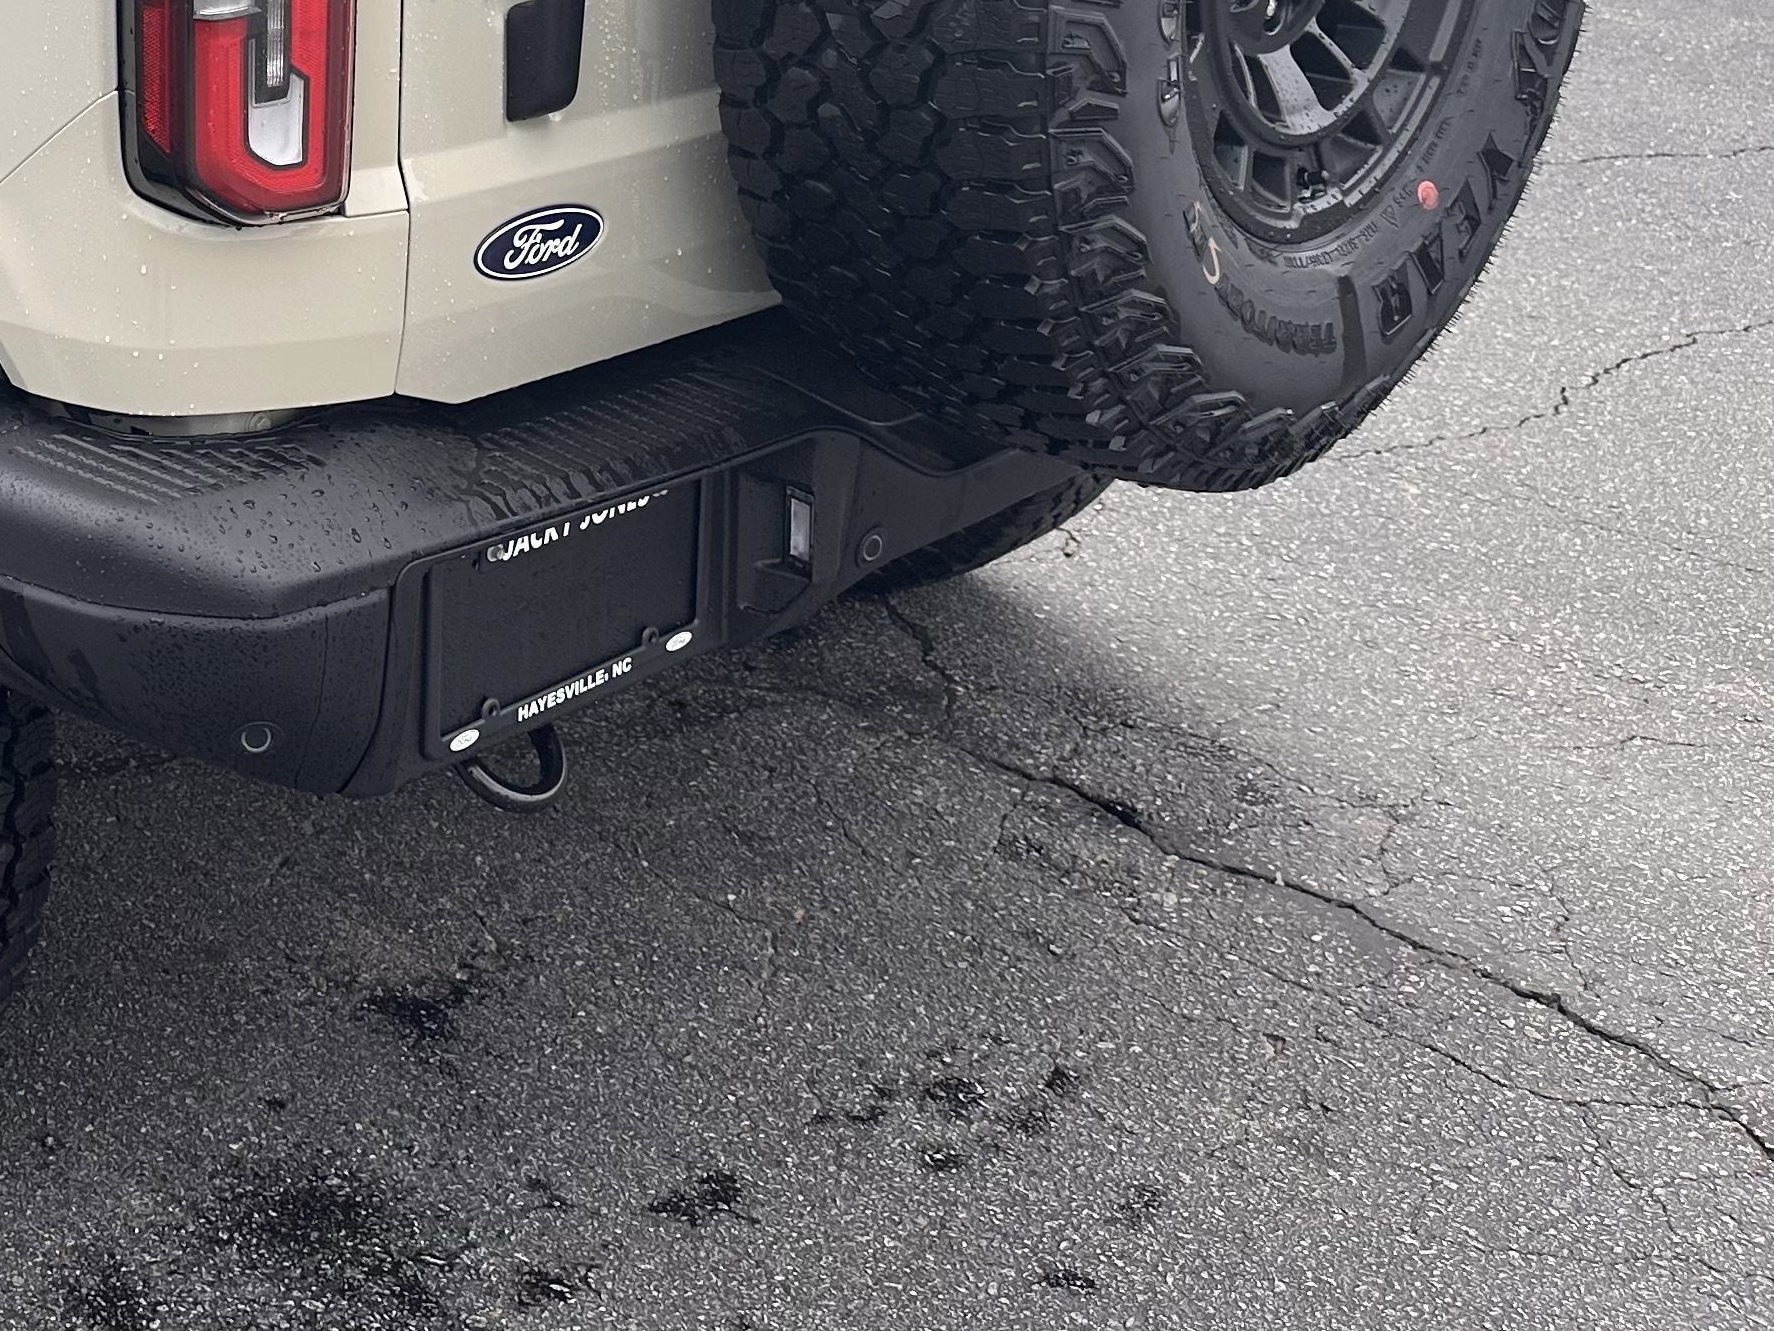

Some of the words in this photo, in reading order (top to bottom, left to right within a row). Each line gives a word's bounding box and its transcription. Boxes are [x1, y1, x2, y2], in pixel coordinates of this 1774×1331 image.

[503, 218, 583, 270] Ford
[517, 668, 609, 722] HAYESVILLE,
[611, 657, 633, 679] NC
